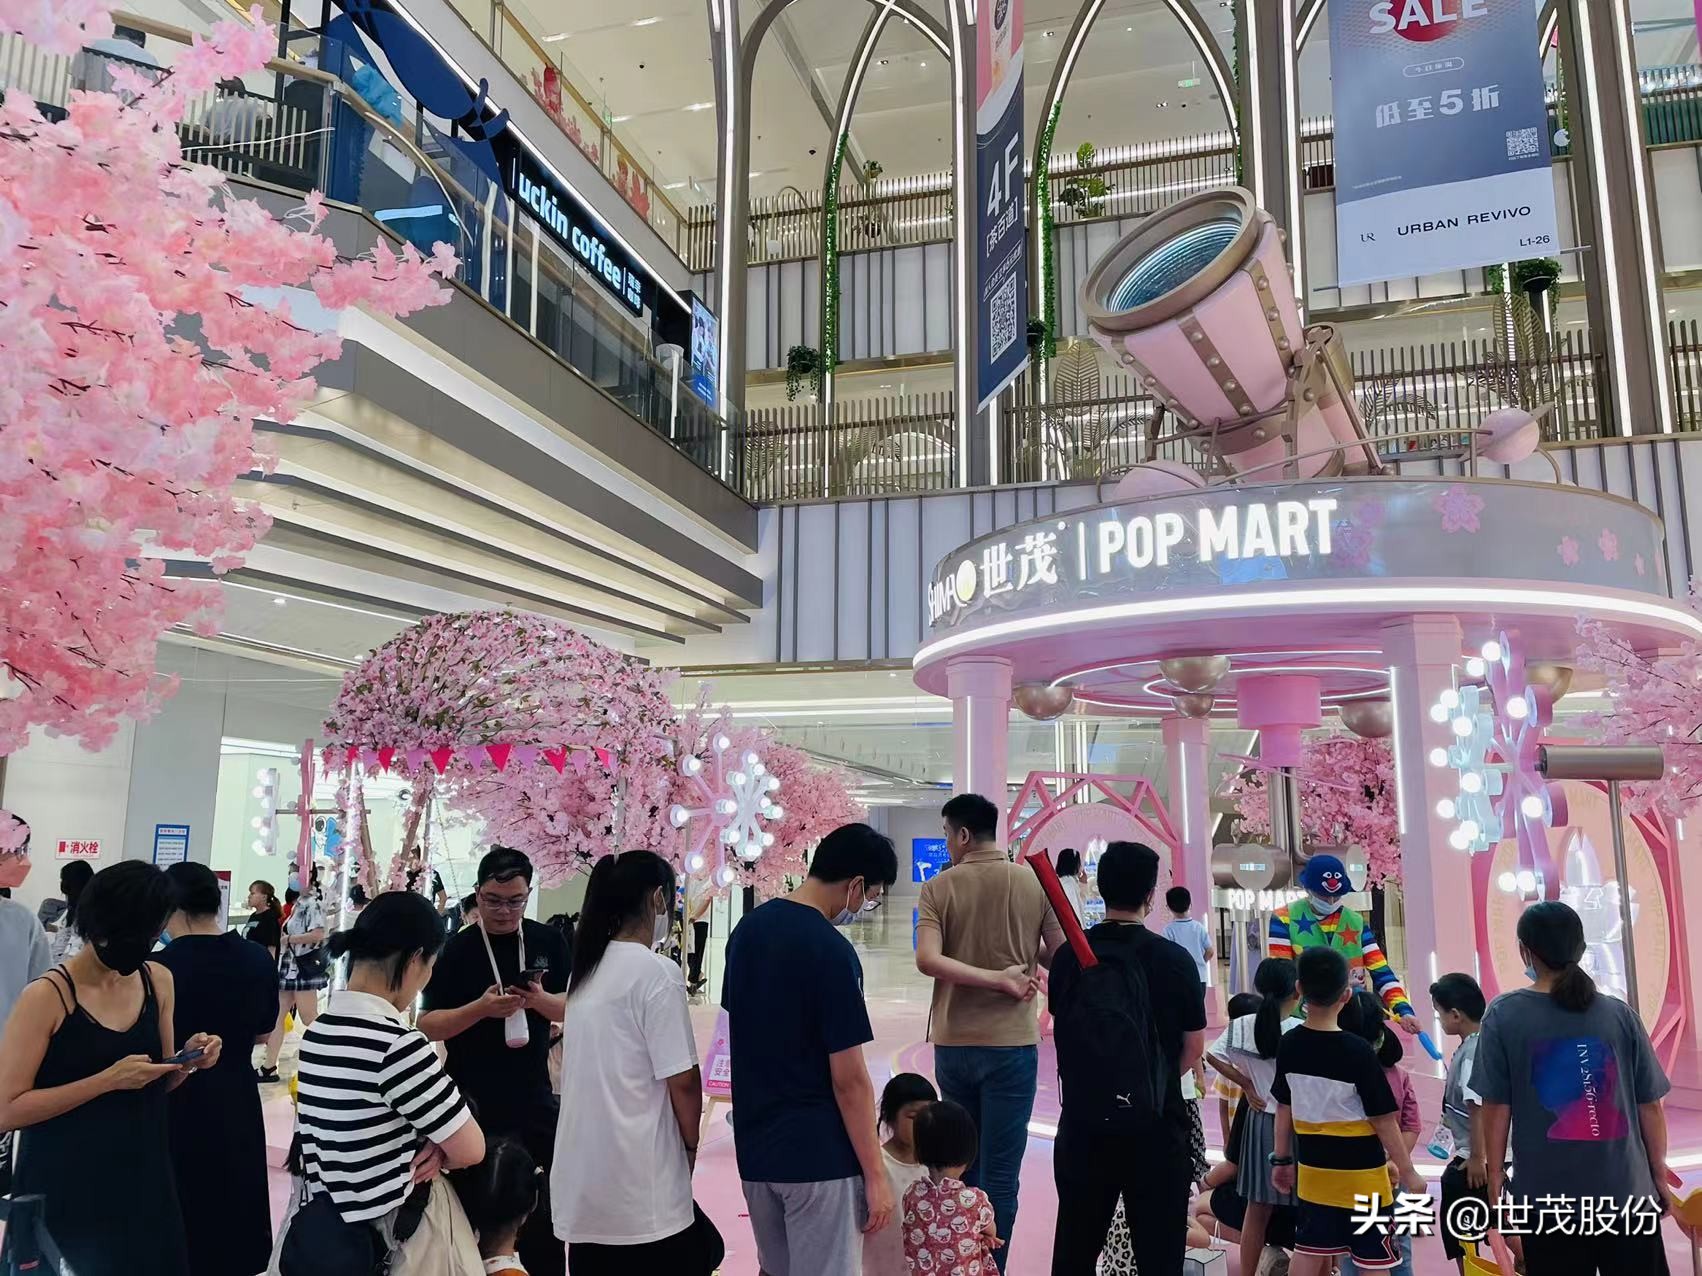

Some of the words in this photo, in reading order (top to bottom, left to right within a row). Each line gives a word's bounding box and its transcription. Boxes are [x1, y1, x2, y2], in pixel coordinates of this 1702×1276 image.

[1369, 0, 1488, 34] SALE
[1376, 84, 1500, 128] 低至5折
[987, 132, 1019, 217] 4F
[1397, 217, 1459, 236] URBAN
[1467, 206, 1532, 225] REVIVO
[571, 225, 622, 290] coffee
[1519, 235, 1550, 247] L1-26
[979, 532, 1058, 598] 世茂
[1098, 512, 1184, 573] POP
[1199, 498, 1337, 562] MART
[71, 841, 98, 854] 消火栓
[1228, 888, 1255, 911] POP
